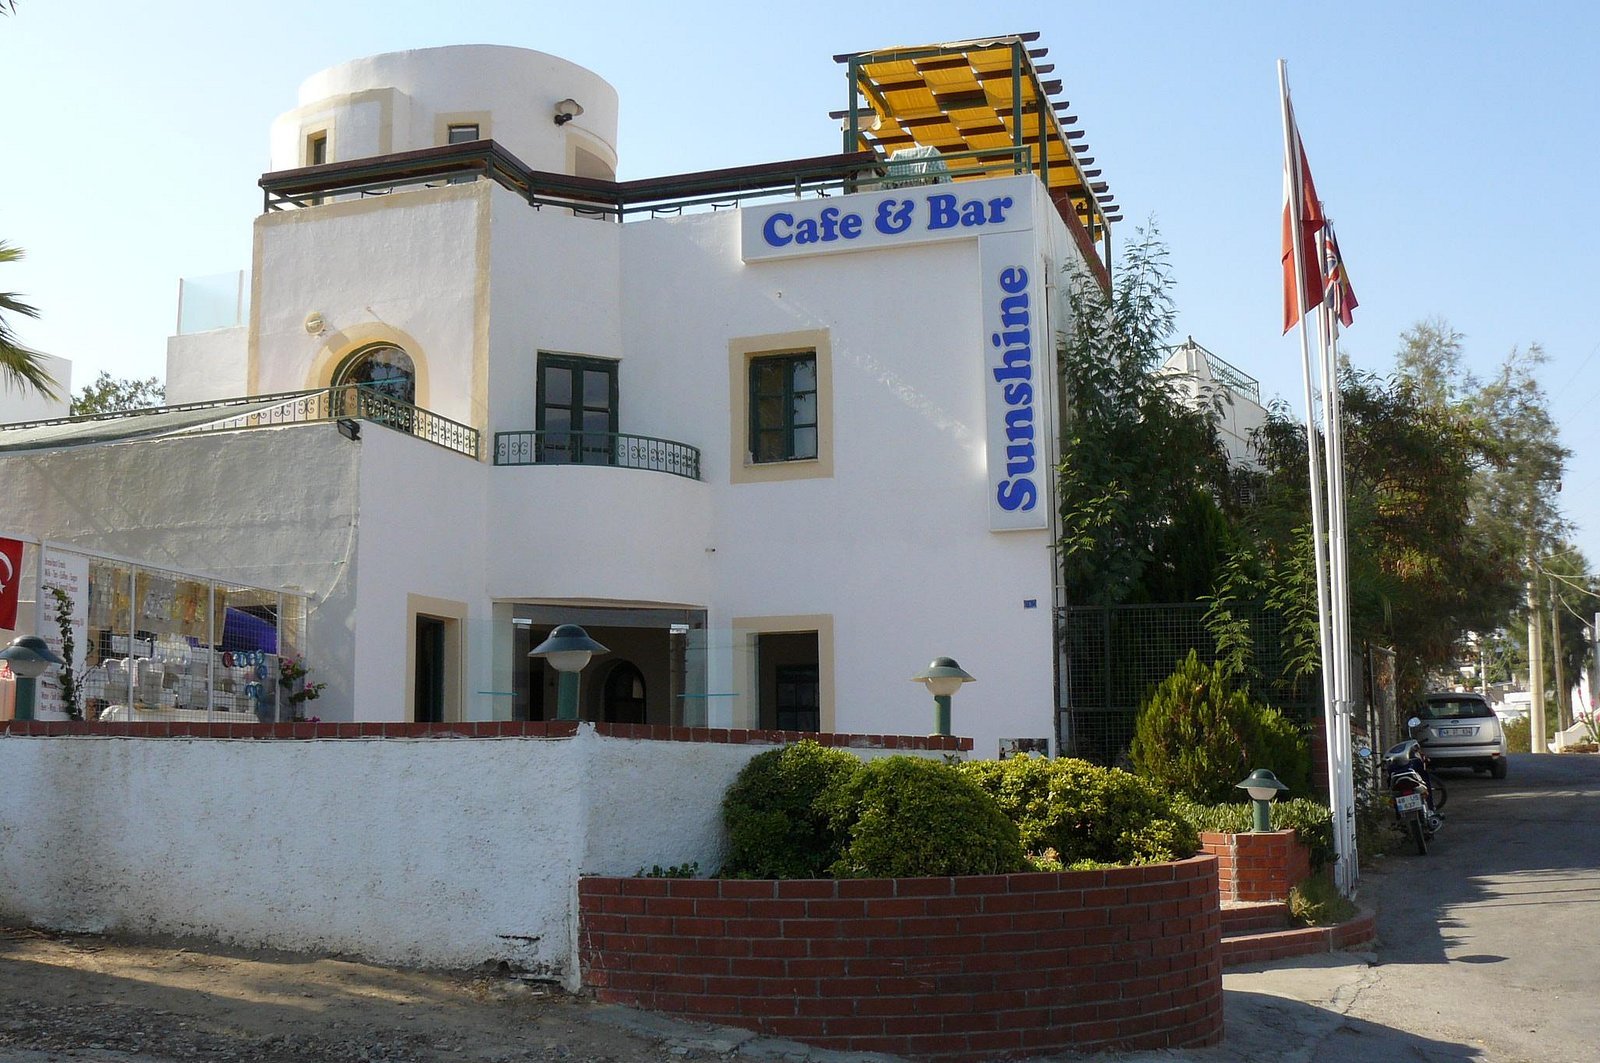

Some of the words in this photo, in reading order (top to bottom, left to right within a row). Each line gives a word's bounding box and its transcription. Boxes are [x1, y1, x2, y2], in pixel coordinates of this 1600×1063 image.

[763, 207, 863, 248] Cafe
[875, 199, 917, 235] &
[926, 193, 1015, 231] Bar
[992, 266, 1038, 512] Sunshine
